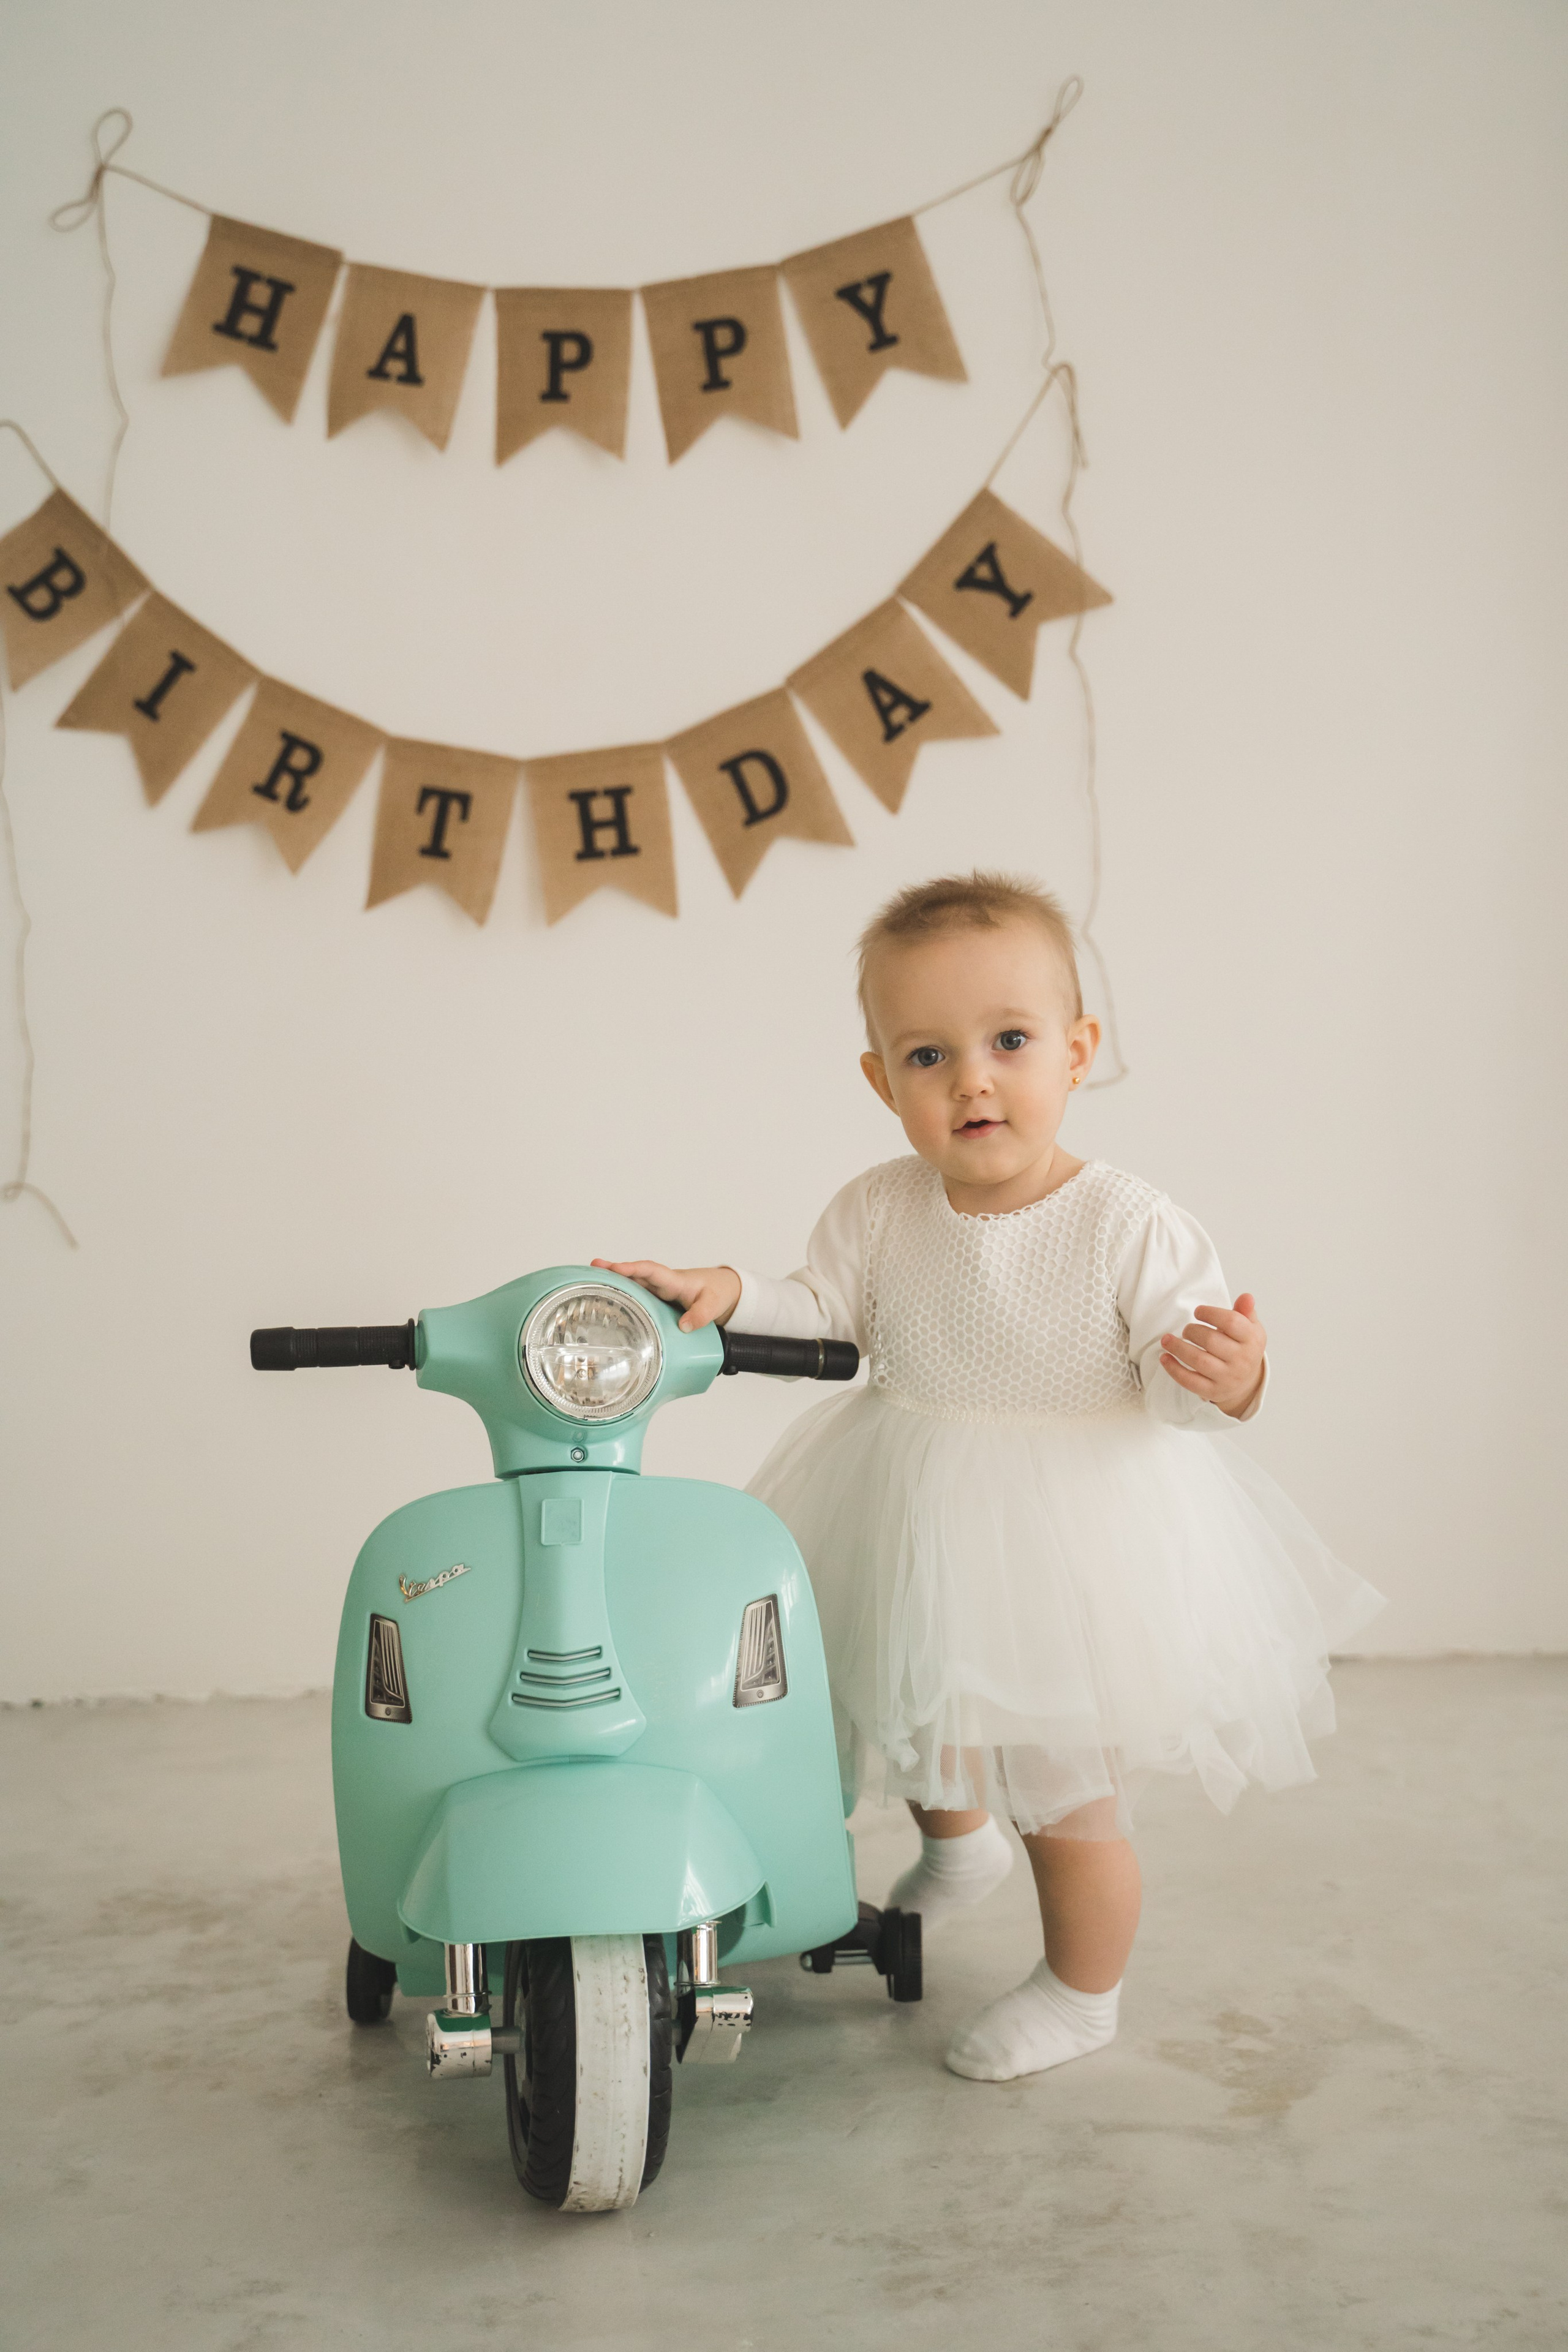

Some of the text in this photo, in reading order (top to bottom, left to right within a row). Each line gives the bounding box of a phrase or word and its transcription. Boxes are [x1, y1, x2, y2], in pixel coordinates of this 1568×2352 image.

[211, 265, 899, 403] HAPPY
[6, 542, 1033, 862] BIRTHDAY
[399, 1562, 471, 1603] Vespa
